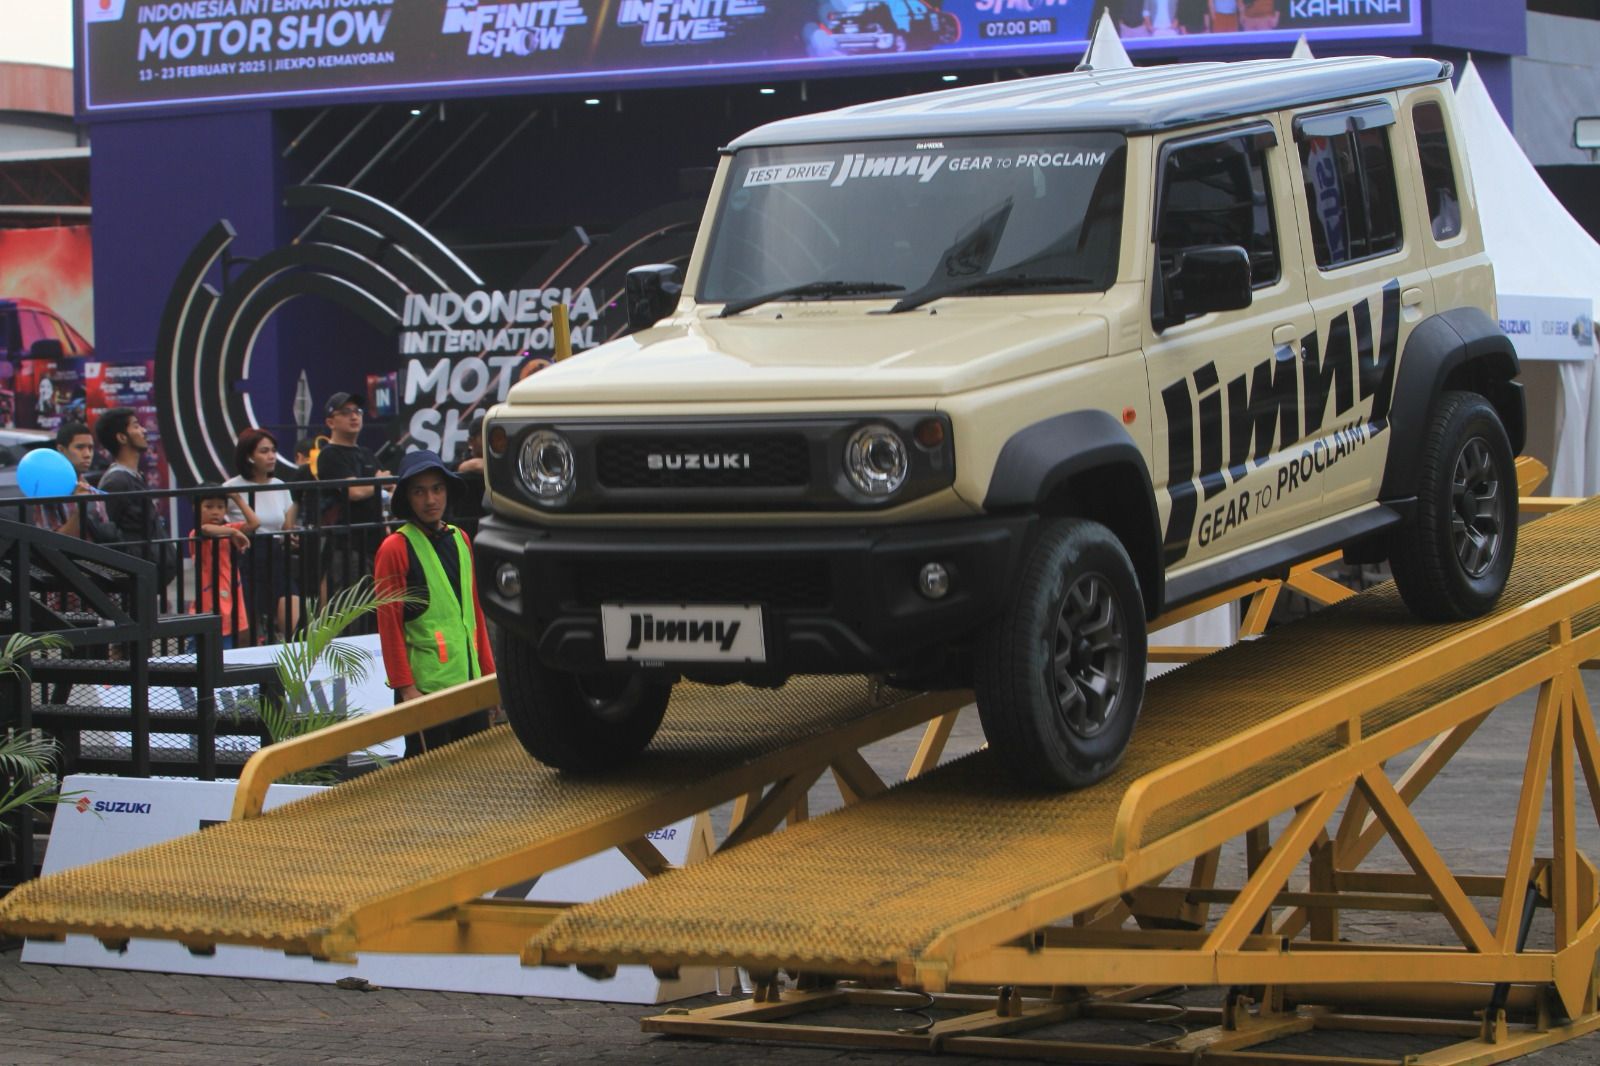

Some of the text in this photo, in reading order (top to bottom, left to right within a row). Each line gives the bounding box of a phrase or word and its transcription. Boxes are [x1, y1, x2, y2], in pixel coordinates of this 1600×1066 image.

[138, 0, 237, 24] INDONESIA
[1290, 0, 1401, 18] KAHITNA
[137, 9, 393, 61] MOTOR SHOW
[477, 26, 567, 58] SHOW
[986, 21, 1025, 36] 07.00
[138, 69, 153, 81] 13
[160, 67, 175, 79] 23
[177, 62, 236, 78] FEBRUARY
[238, 60, 266, 73] 2025
[274, 57, 316, 71] JIEXPO
[318, 51, 395, 68] KEMAYORAN
[749, 151, 1106, 187] TEST DRIVE Jimny GEAR TO PROCLAIM
[402, 287, 599, 327] INDONESIA
[404, 356, 525, 405] MOT
[1161, 278, 1401, 567] Jimny
[647, 453, 750, 470] SUZUKI
[1198, 416, 1365, 547] GEAR TO PROCLAIM
[626, 612, 742, 652] Jimny
[94, 800, 152, 814] SUZUKI
